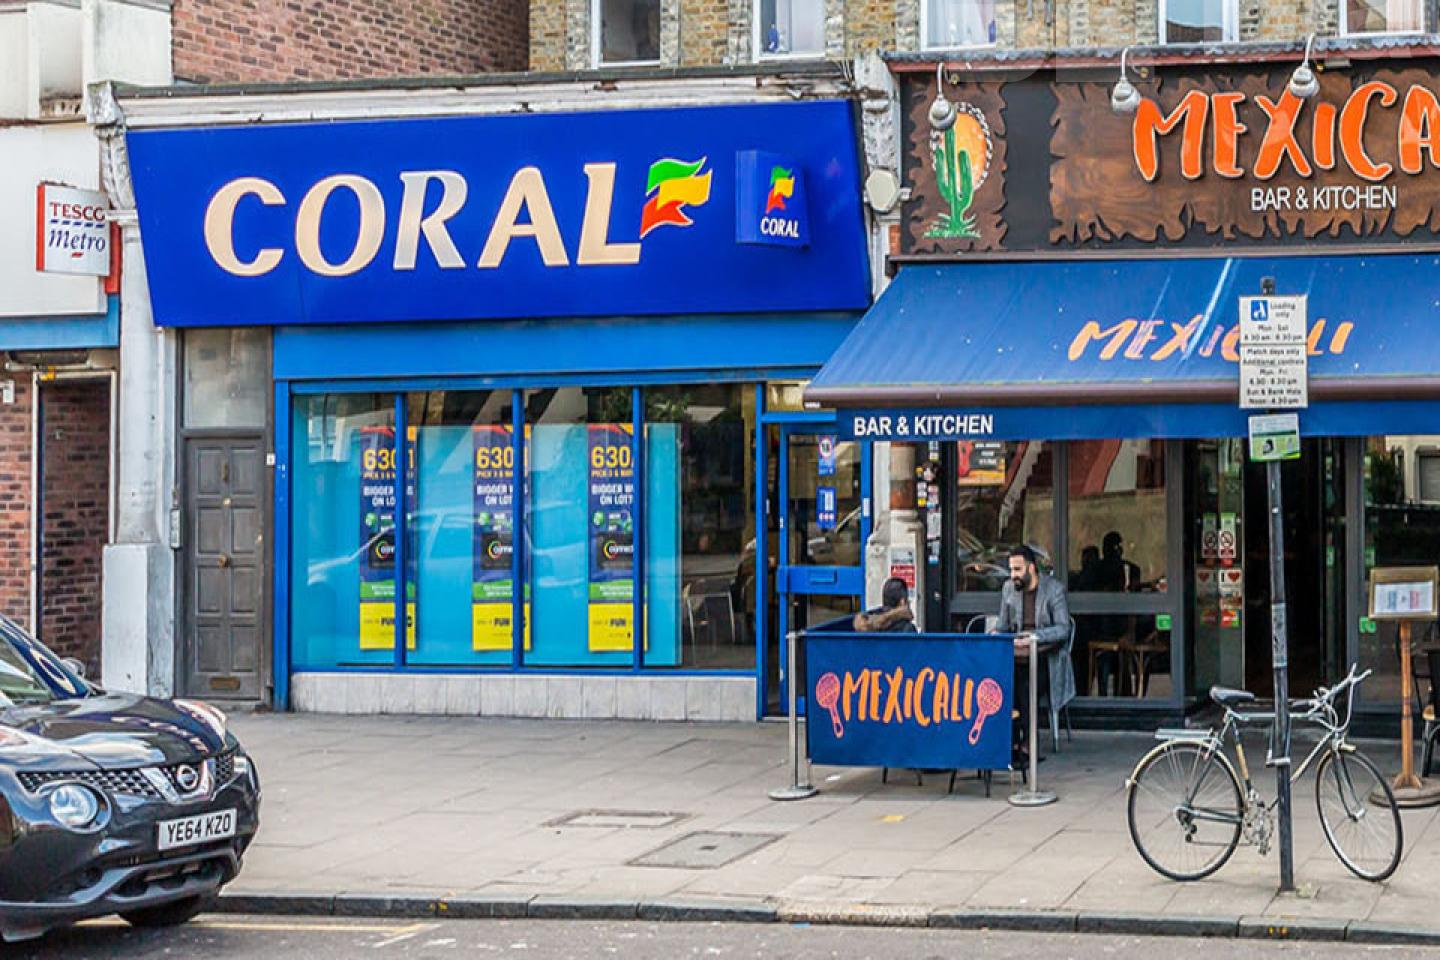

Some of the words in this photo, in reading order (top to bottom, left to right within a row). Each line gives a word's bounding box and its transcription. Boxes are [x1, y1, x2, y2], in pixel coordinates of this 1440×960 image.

[1251, 187, 1290, 211] BAR
[1296, 187, 1309, 210] &
[1313, 186, 1397, 210] KITCHEN
[50, 201, 106, 222] TESCO
[204, 162, 642, 277] CORAL
[761, 217, 799, 238] CORAL
[49, 229, 106, 253] Metro
[854, 416, 892, 436] BAR
[896, 416, 910, 435] &
[914, 414, 994, 435] KITCHEN
[842, 666, 974, 727] MEXICALI
[168, 819, 202, 844] YE64
[206, 813, 231, 837] KZO
